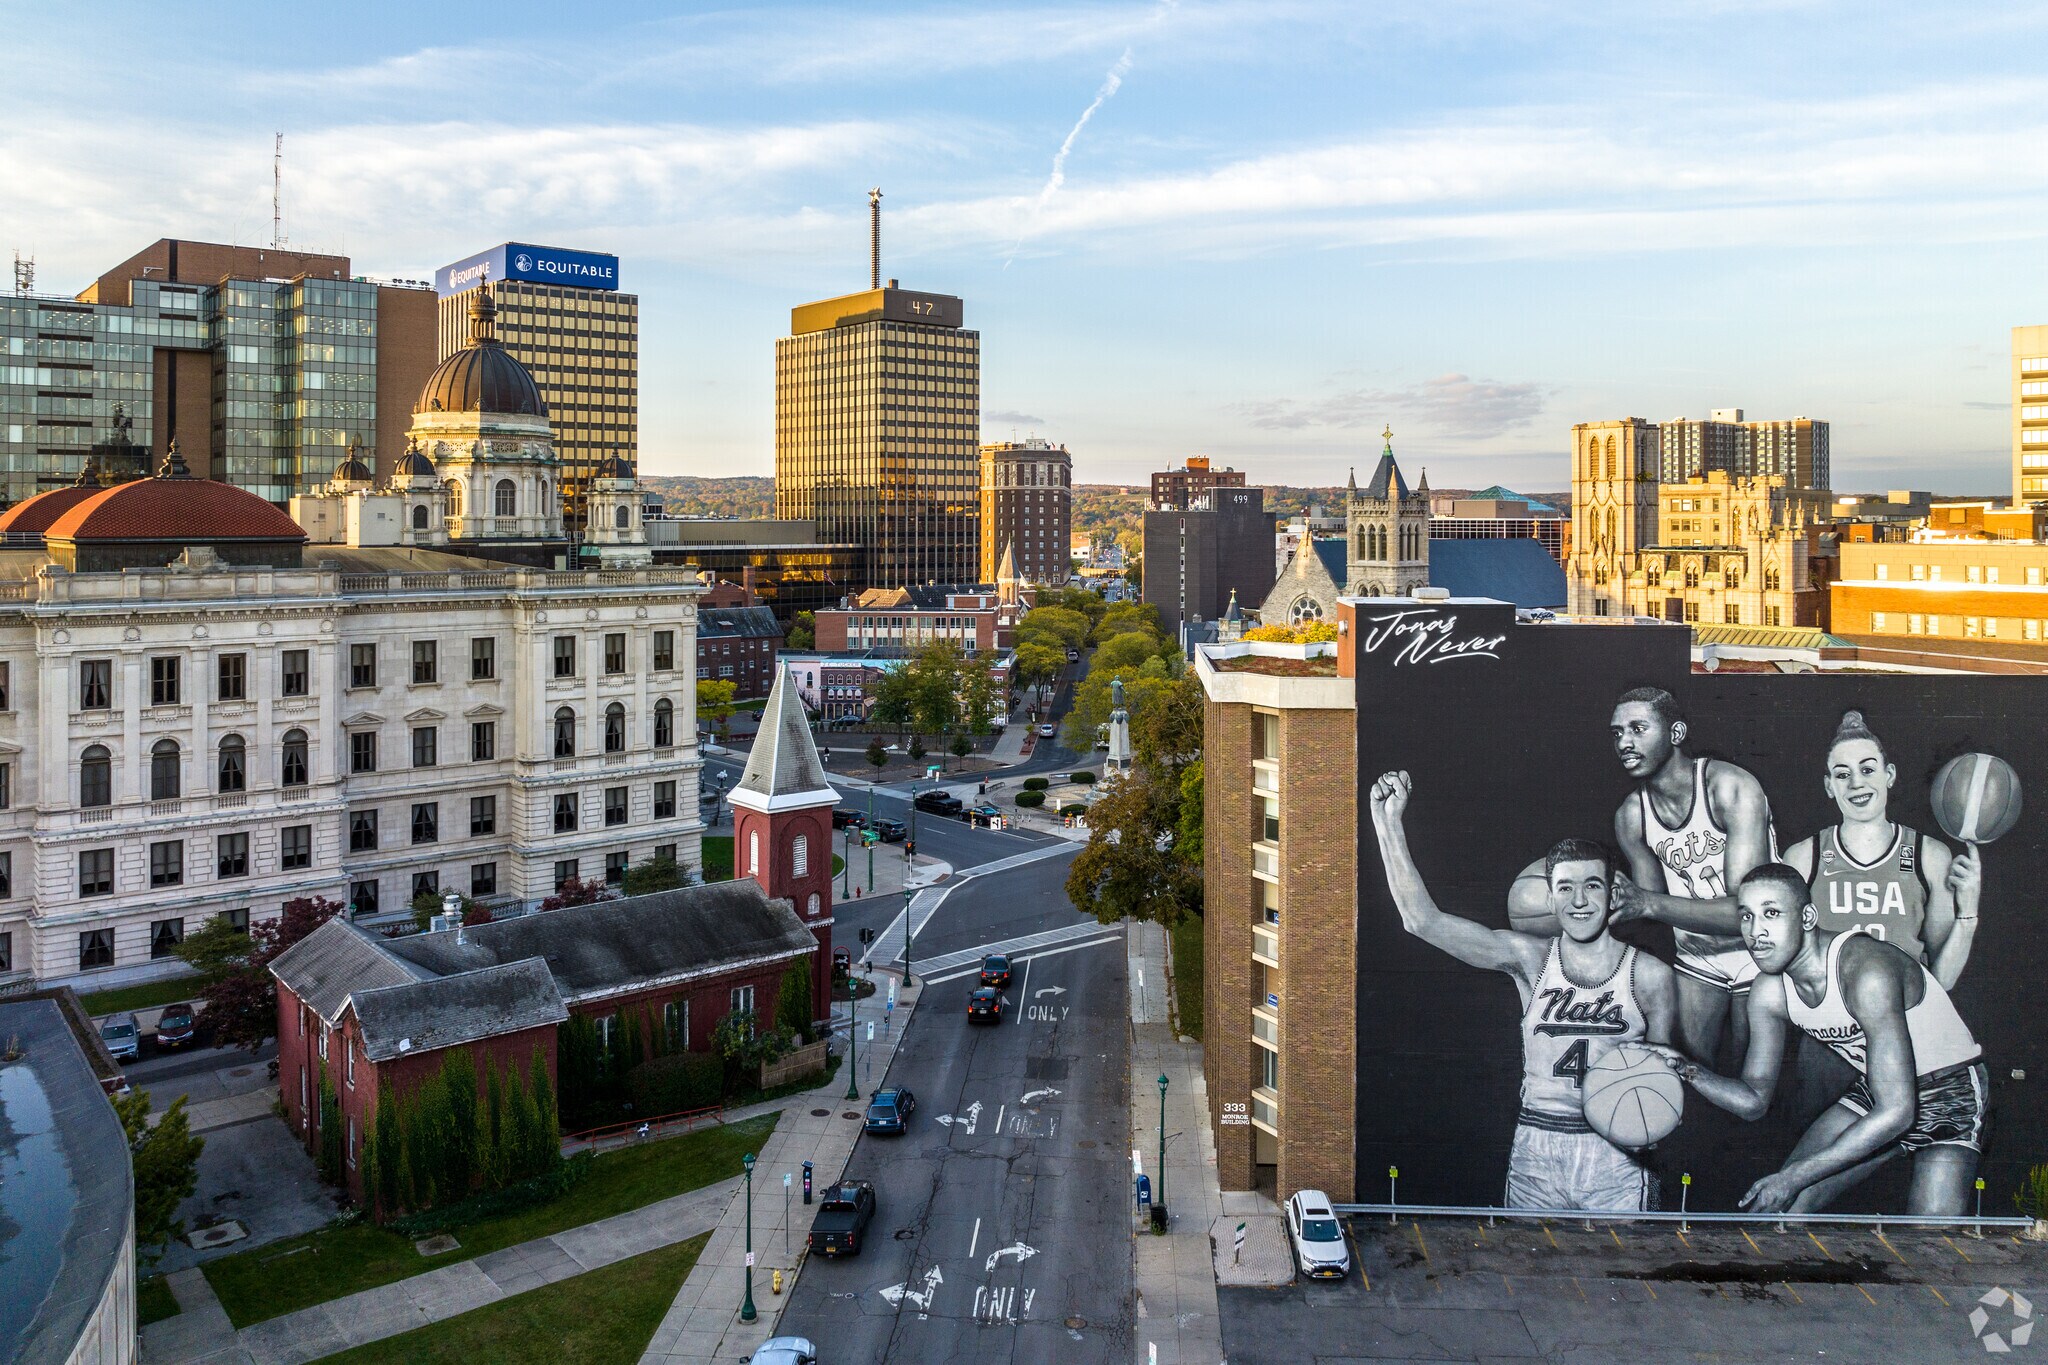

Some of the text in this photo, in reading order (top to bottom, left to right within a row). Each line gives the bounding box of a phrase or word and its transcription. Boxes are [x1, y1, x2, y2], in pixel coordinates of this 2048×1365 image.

[457, 262, 490, 284] EQUITABLE
[537, 260, 613, 278] EQUITABLE
[1233, 495, 1248, 504] 499
[1365, 609, 1457, 653] Jonas
[1394, 631, 1507, 666] Never
[1829, 881, 1906, 915] USA
[1028, 1005, 1069, 1021] ONLY
[1539, 987, 1626, 1024] Nats
[1553, 1038, 1590, 1089] 4
[1224, 1103, 1246, 1112] 333
[973, 1286, 1036, 1325] ONLY
